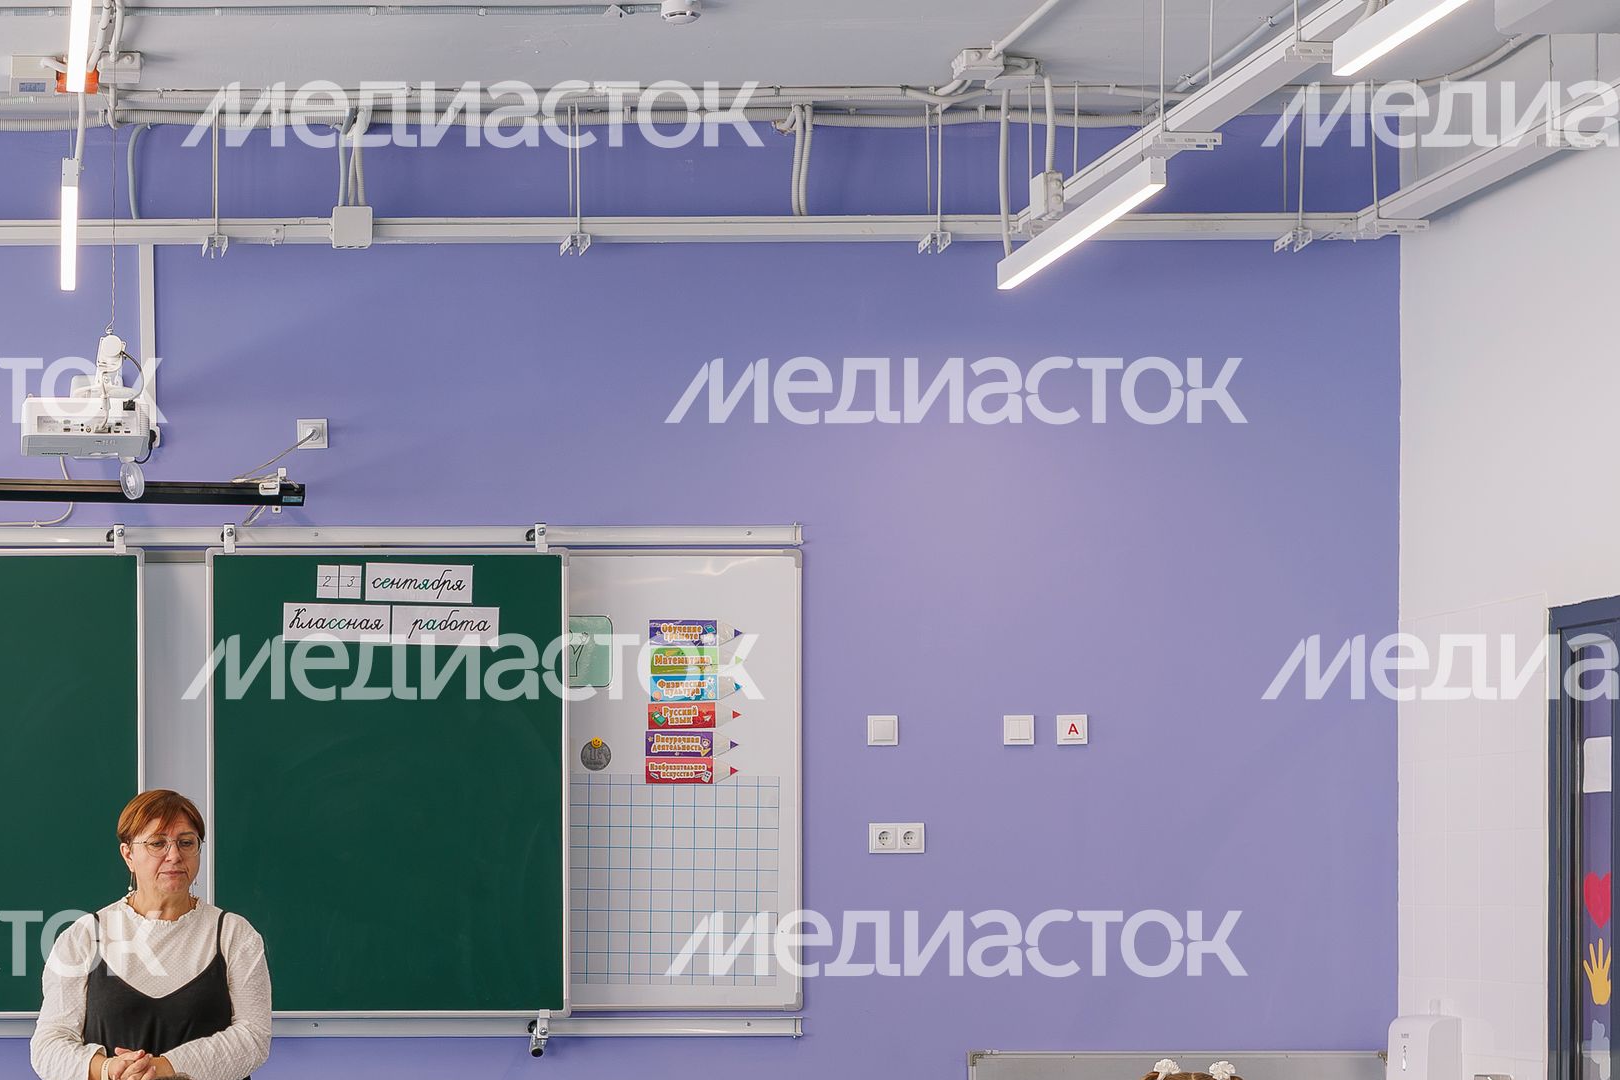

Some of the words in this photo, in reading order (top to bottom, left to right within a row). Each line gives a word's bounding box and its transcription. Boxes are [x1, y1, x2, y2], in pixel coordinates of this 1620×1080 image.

[371, 569, 467, 600] сентября
[288, 607, 385, 630] Классная
[407, 609, 492, 639] работа
[661, 624, 703, 634] Обучение
[654, 655, 711, 665] Математика
[657, 680, 707, 689] Физическая
[662, 706, 698, 717] Русский
[669, 717, 693, 725] язык
[655, 734, 700, 744] Внеурочная
[651, 744, 702, 752] деятельность
[649, 763, 706, 772] Изобразительное
[661, 771, 694, 779] искусство
